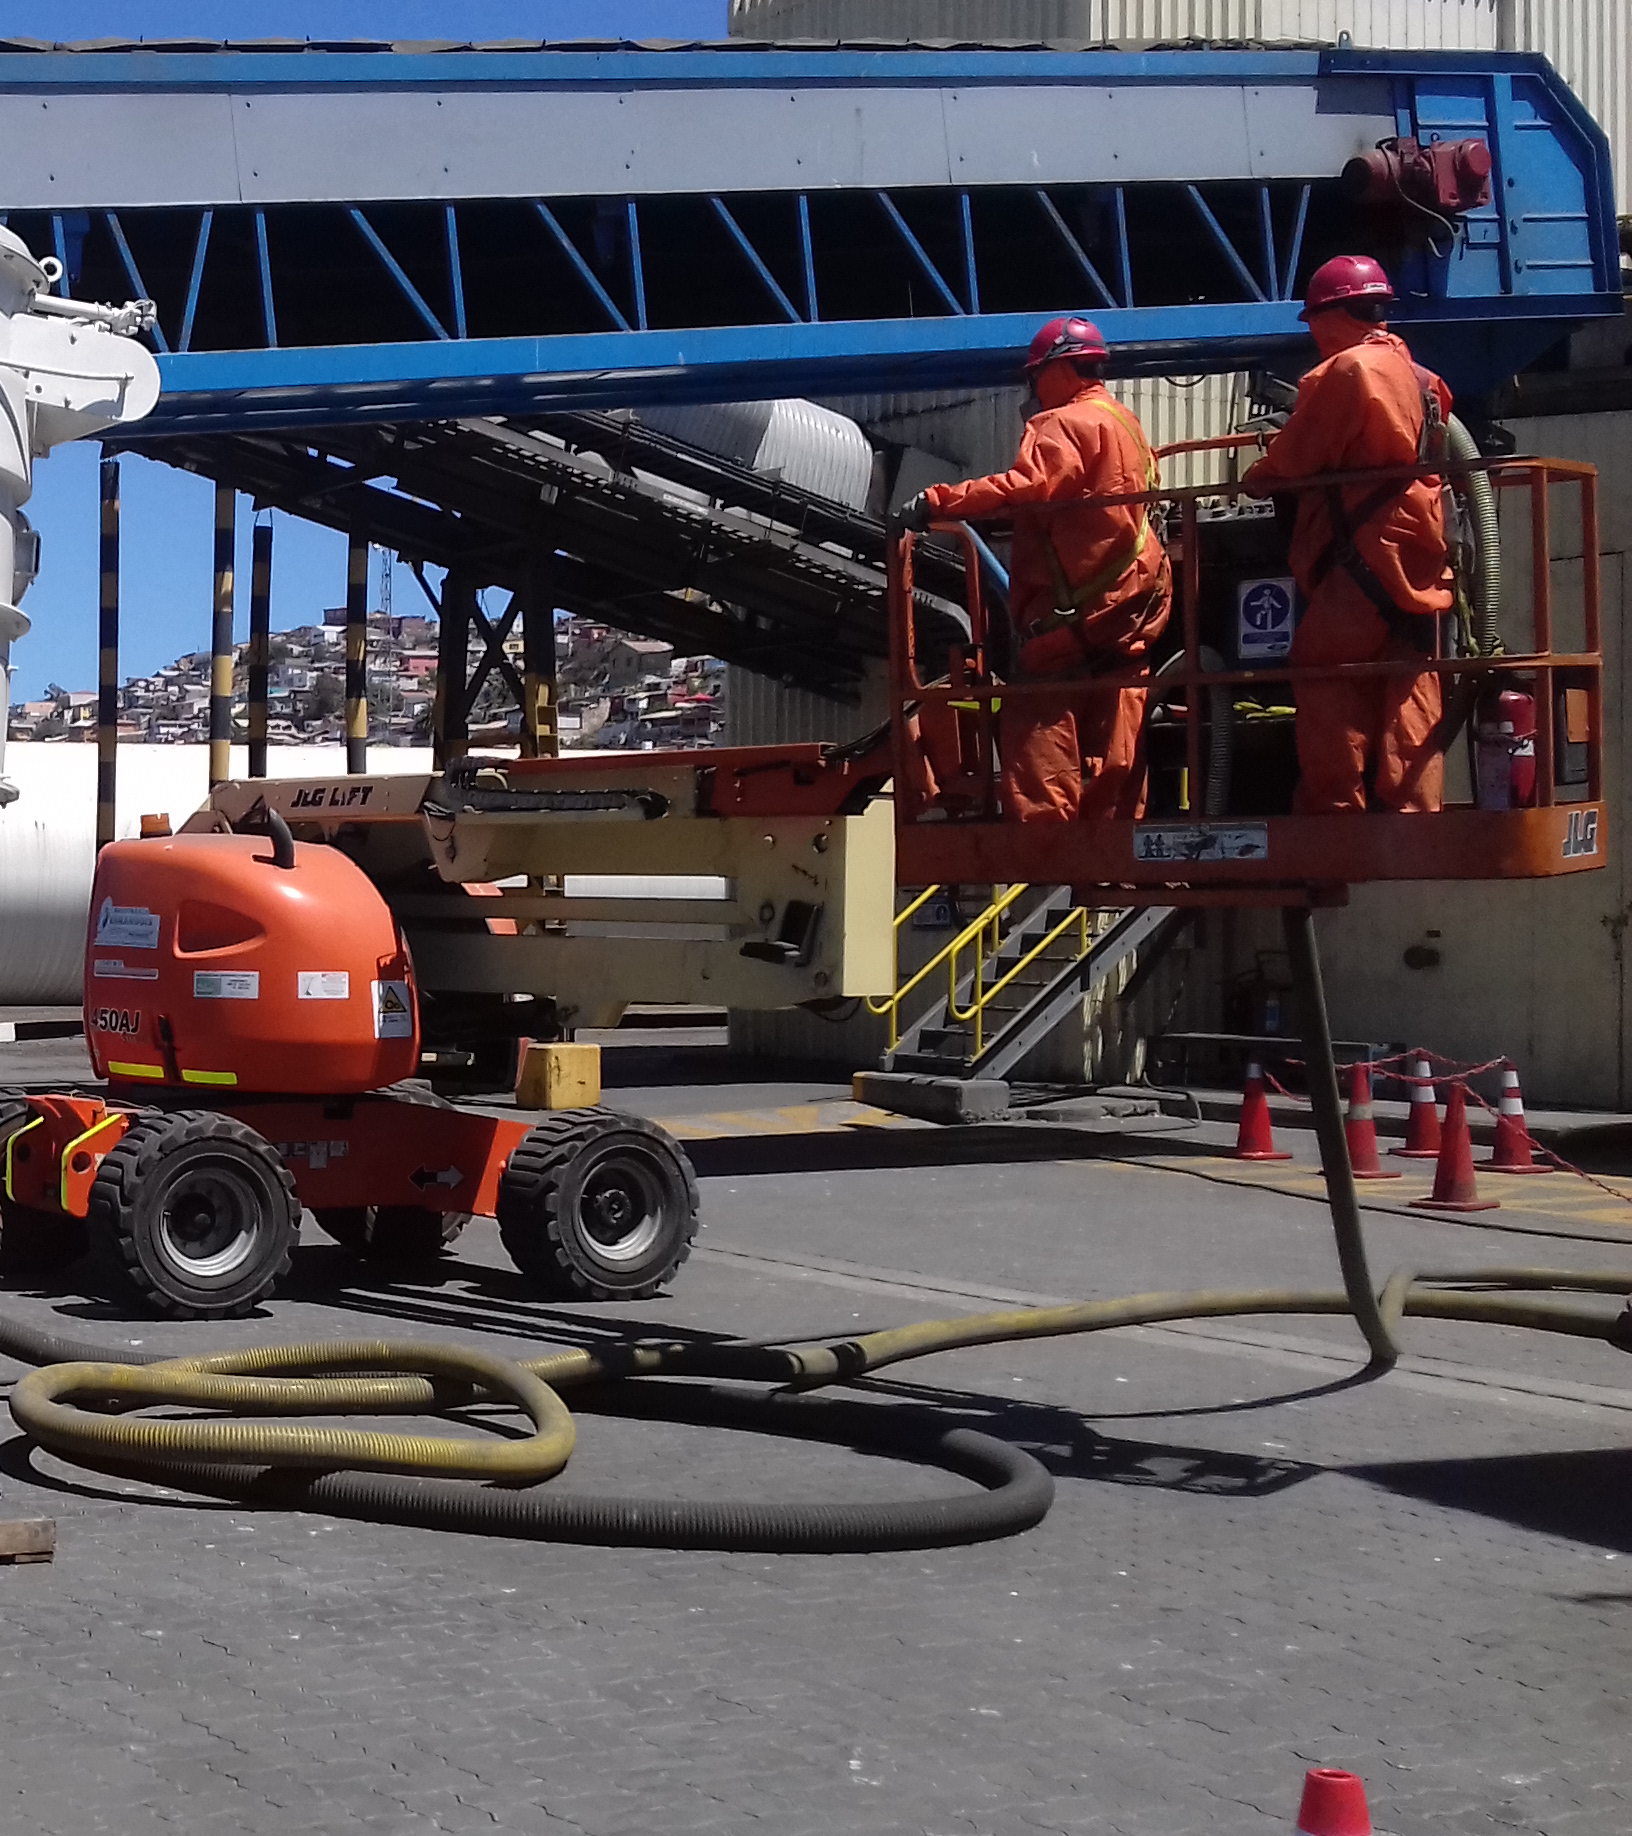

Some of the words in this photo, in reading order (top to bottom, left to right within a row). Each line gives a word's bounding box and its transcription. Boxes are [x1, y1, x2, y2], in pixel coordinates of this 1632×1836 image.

[290, 787, 327, 808] JLG
[328, 785, 374, 807] LIFT
[1562, 809, 1599, 858] JLG
